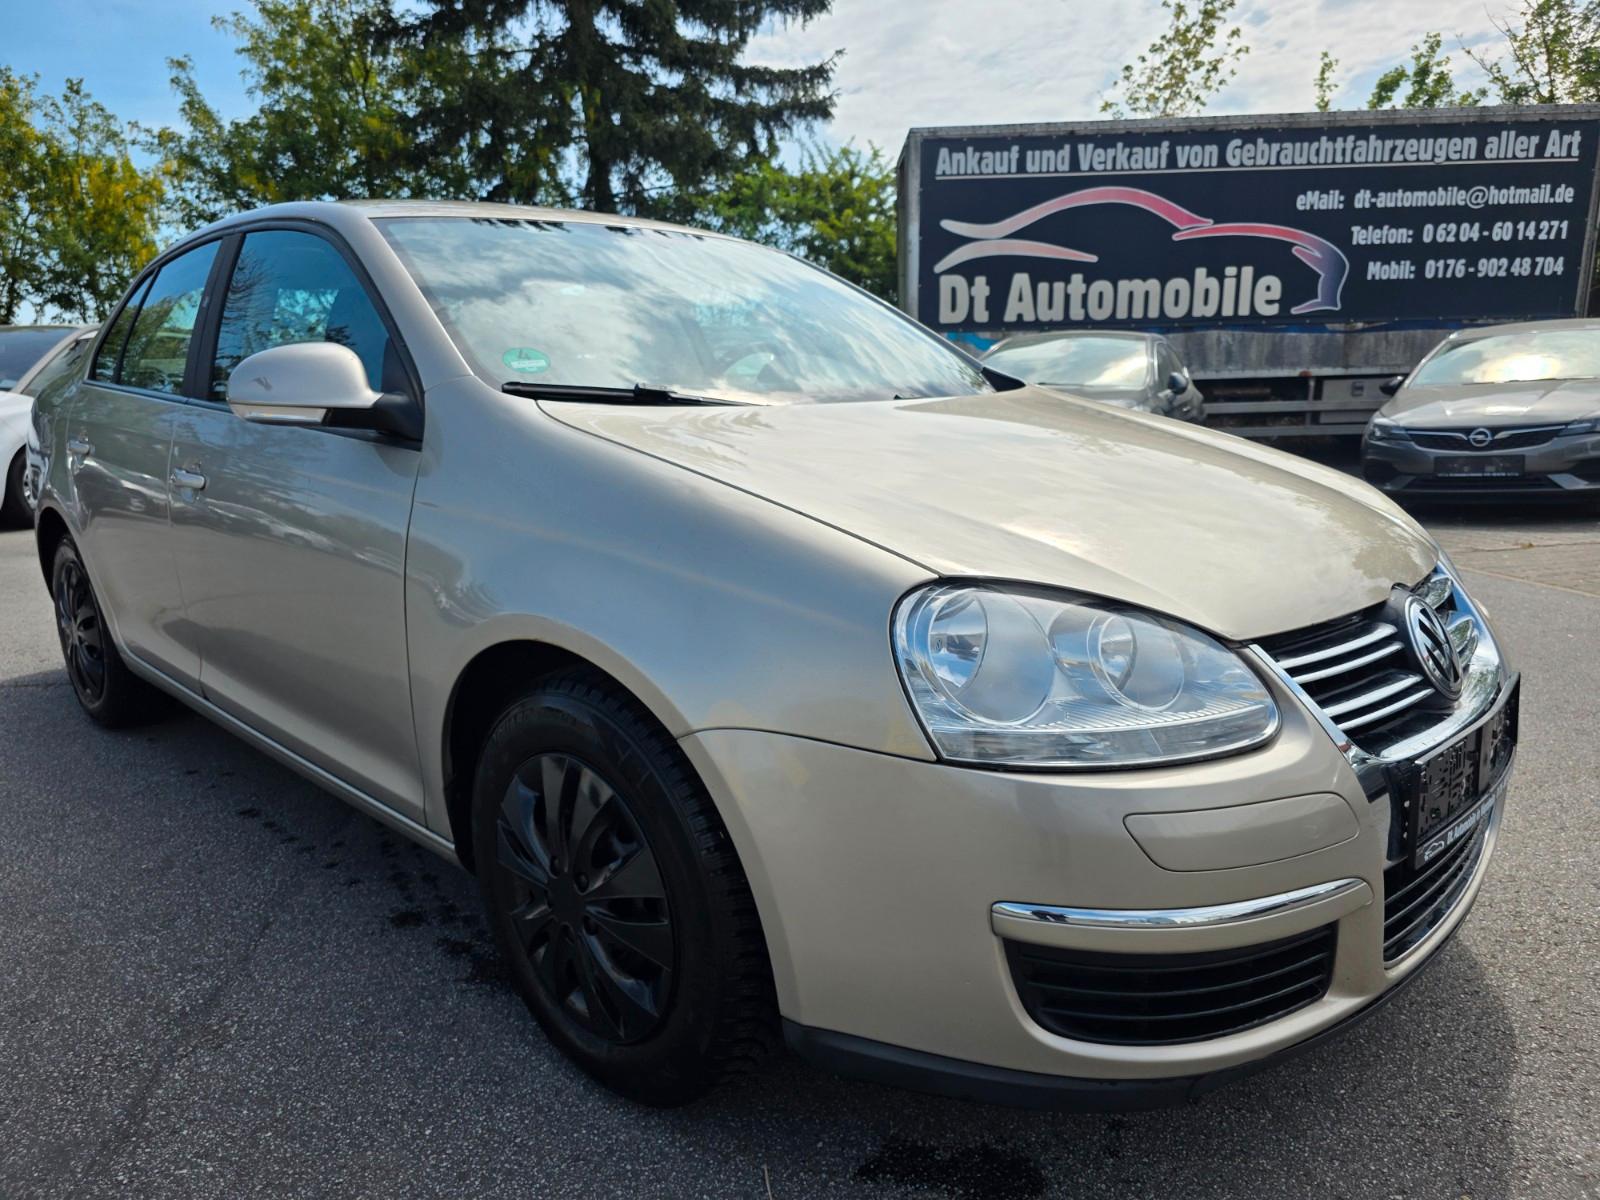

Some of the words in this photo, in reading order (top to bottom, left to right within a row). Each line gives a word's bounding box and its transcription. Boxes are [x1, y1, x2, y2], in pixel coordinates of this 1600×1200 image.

[936, 145, 1020, 176] Ankauf
[1026, 144, 1071, 172] und
[1077, 140, 1170, 171] Verkauf
[1175, 144, 1219, 168] von
[1225, 134, 1478, 164] Gebrauchtfahrzeugen
[1484, 131, 1541, 158] aller
[1543, 130, 1581, 158] Art
[1296, 190, 1345, 211] eMail:
[1353, 184, 1575, 209] dt-automobile@hotmail.de
[1350, 225, 1414, 245] Telefon:
[1367, 261, 1415, 280] Mobil:
[939, 274, 991, 324] Dt
[1003, 266, 1282, 322] Automobile
